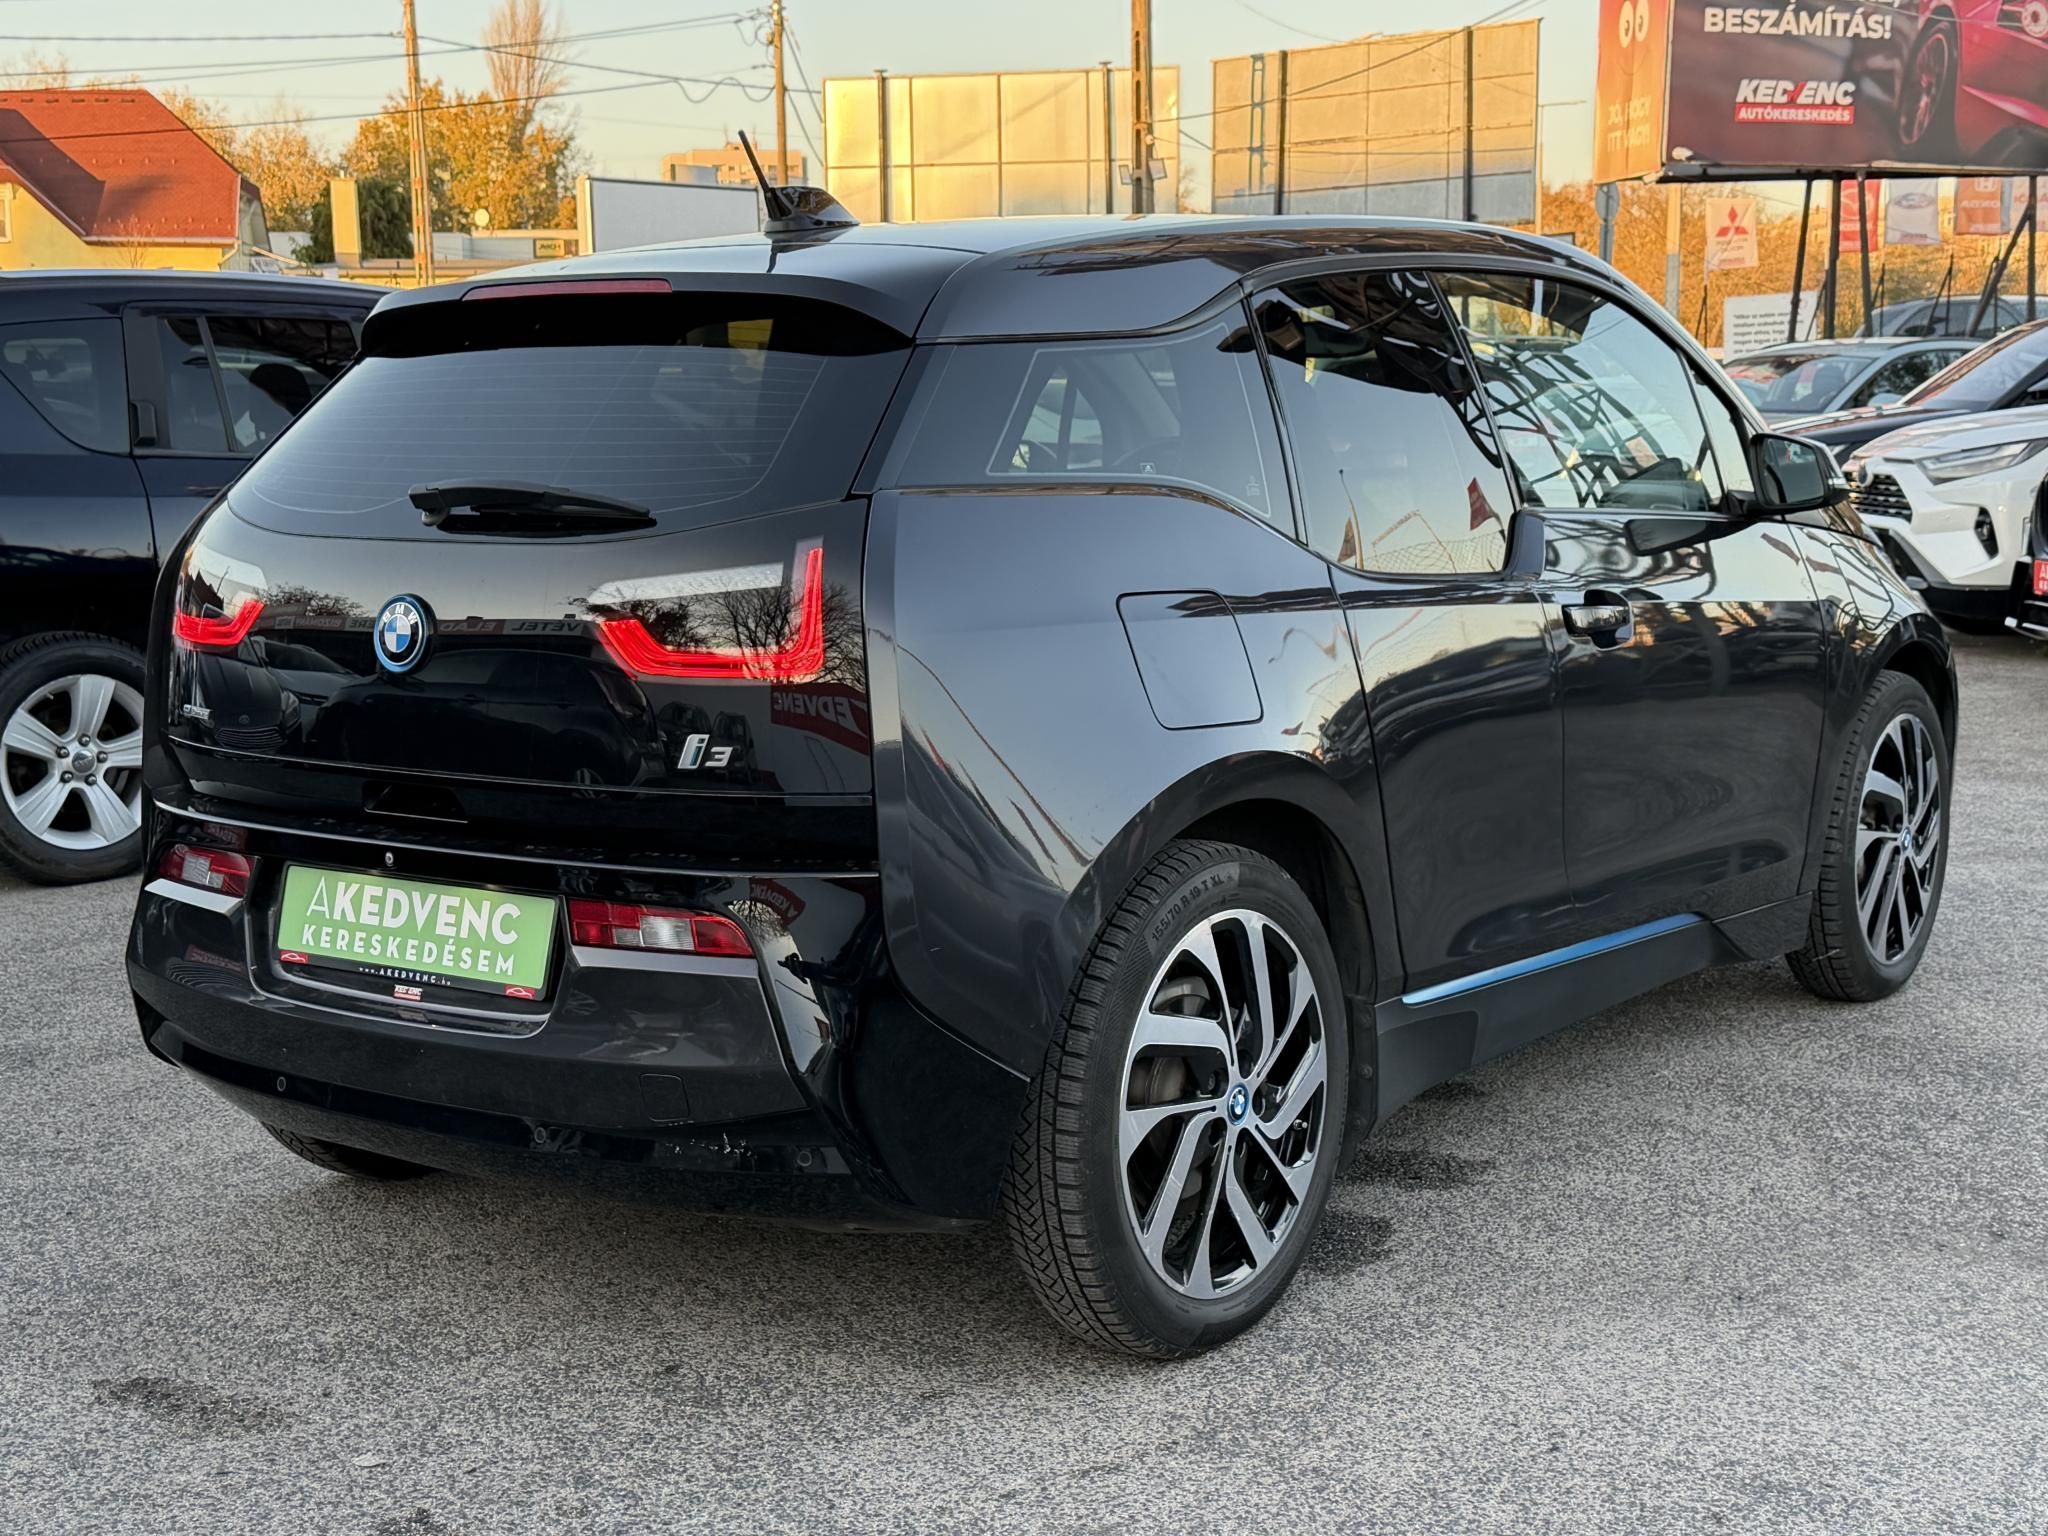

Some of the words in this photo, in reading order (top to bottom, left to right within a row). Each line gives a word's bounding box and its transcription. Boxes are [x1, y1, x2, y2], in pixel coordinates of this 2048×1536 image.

[1703, 3, 1892, 40] BESZÁMÍTÁS!
[1738, 106, 1851, 122] AUTÓKERESKEDÉS
[382, 604, 419, 626] BMW
[677, 733, 734, 769] i3
[301, 923, 515, 977] KERESKEDÉSEM
